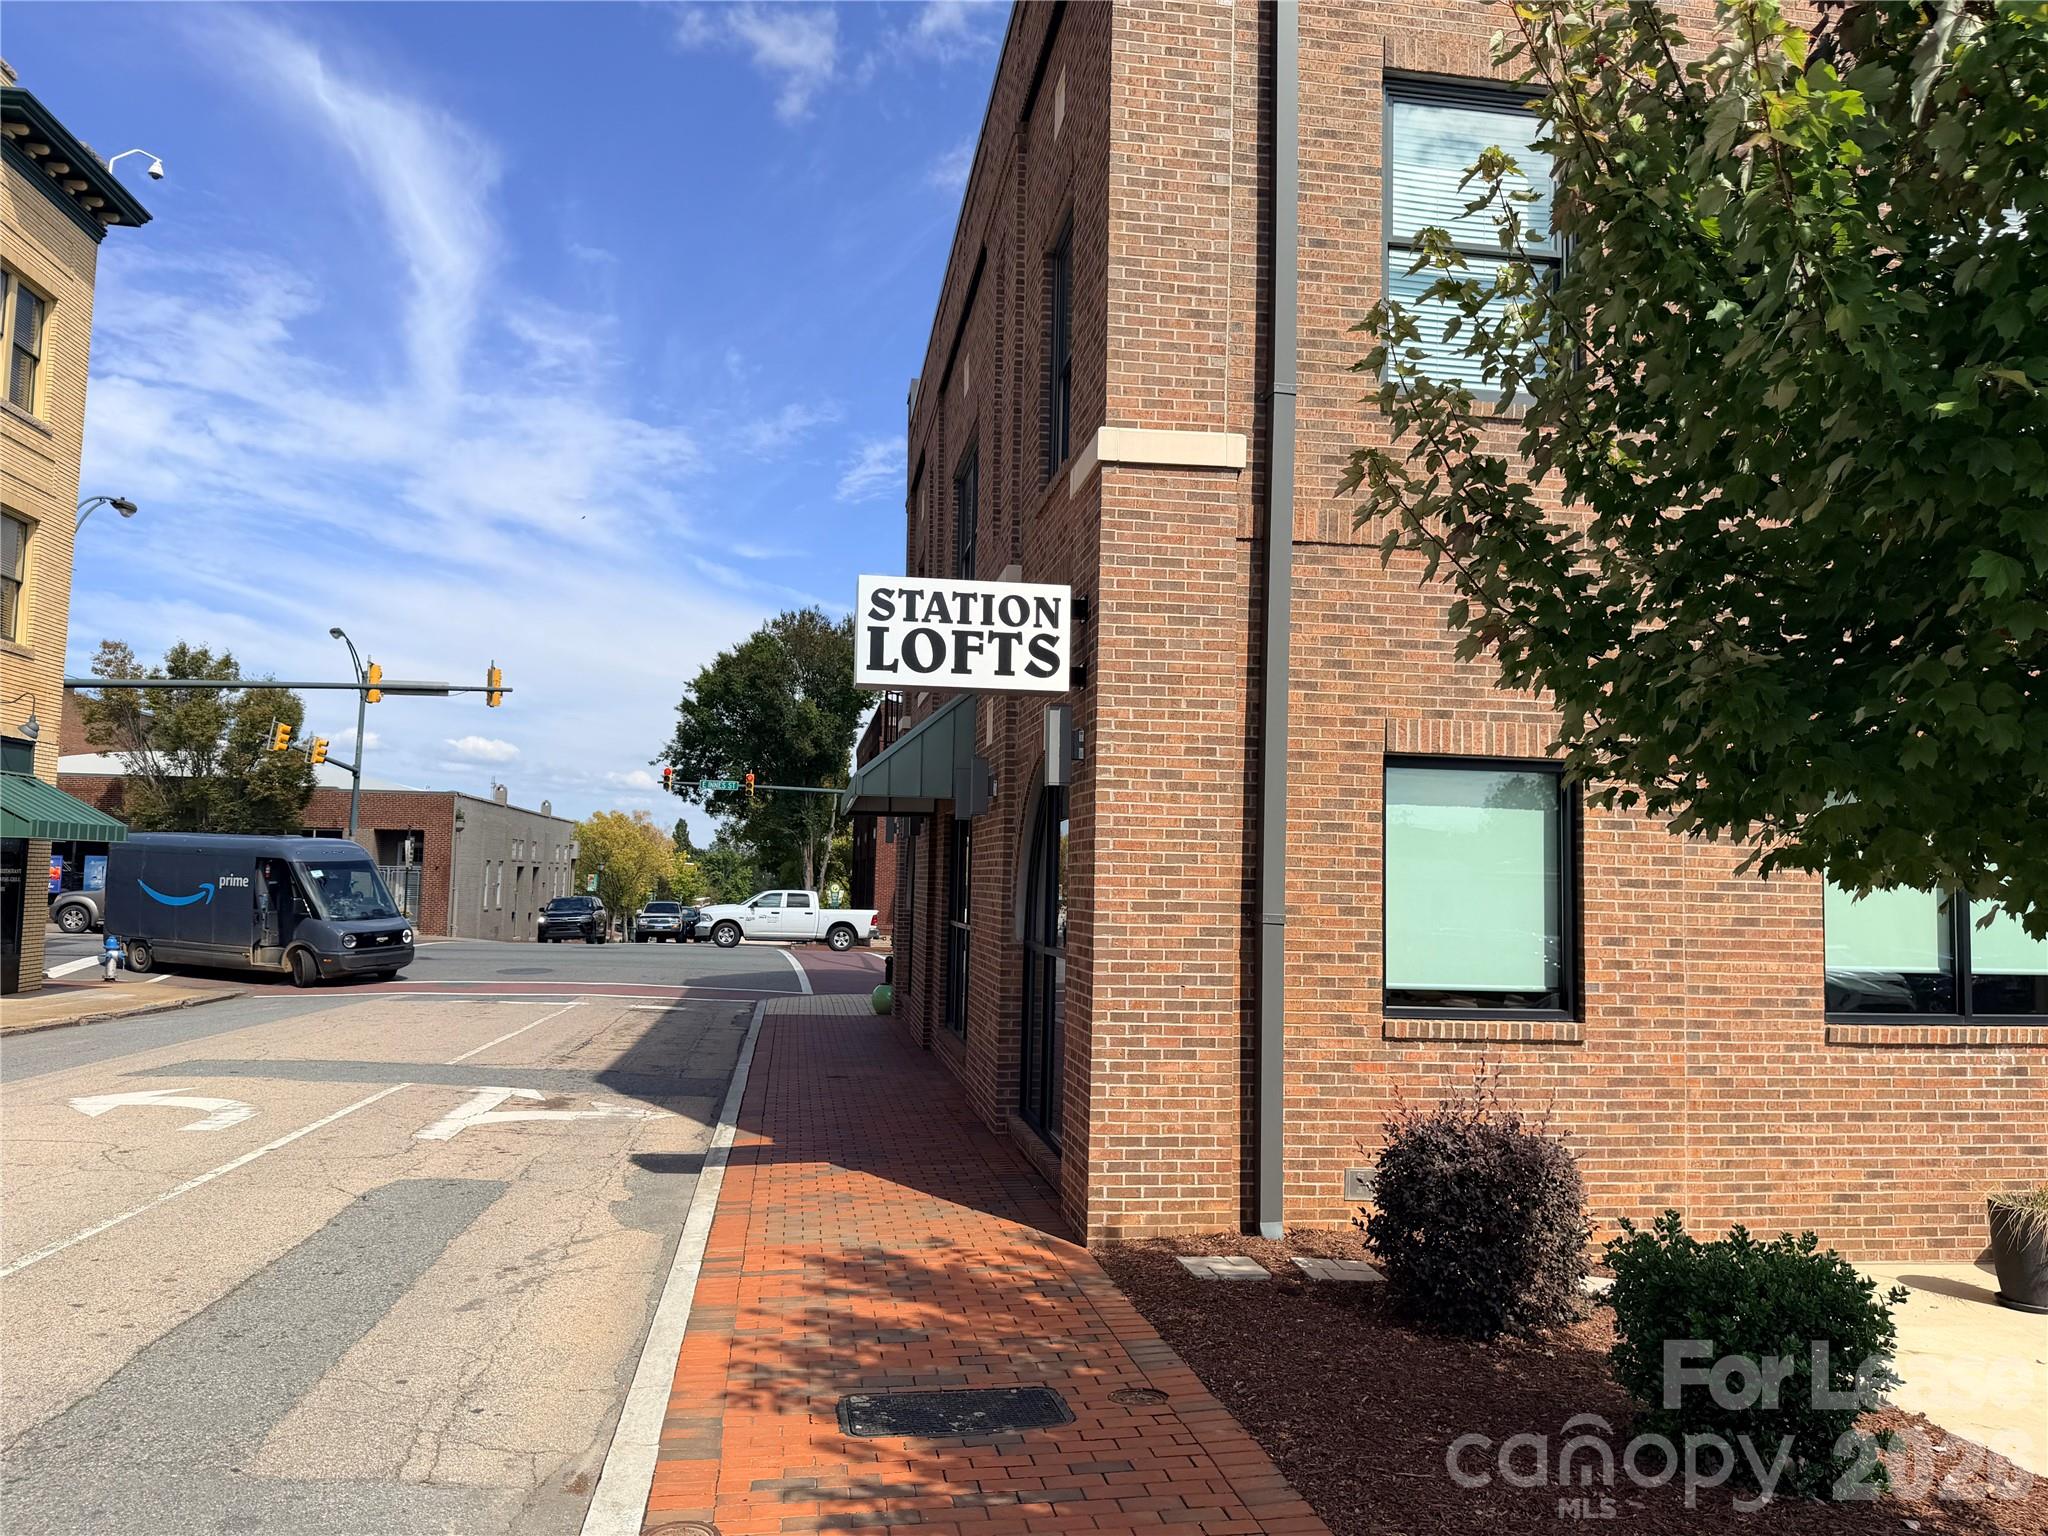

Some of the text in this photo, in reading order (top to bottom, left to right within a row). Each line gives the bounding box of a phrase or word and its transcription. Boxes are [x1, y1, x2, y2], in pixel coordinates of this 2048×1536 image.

[868, 588, 1061, 629] STATION
[866, 626, 1061, 678] LOFTS
[219, 873, 249, 889] prime
